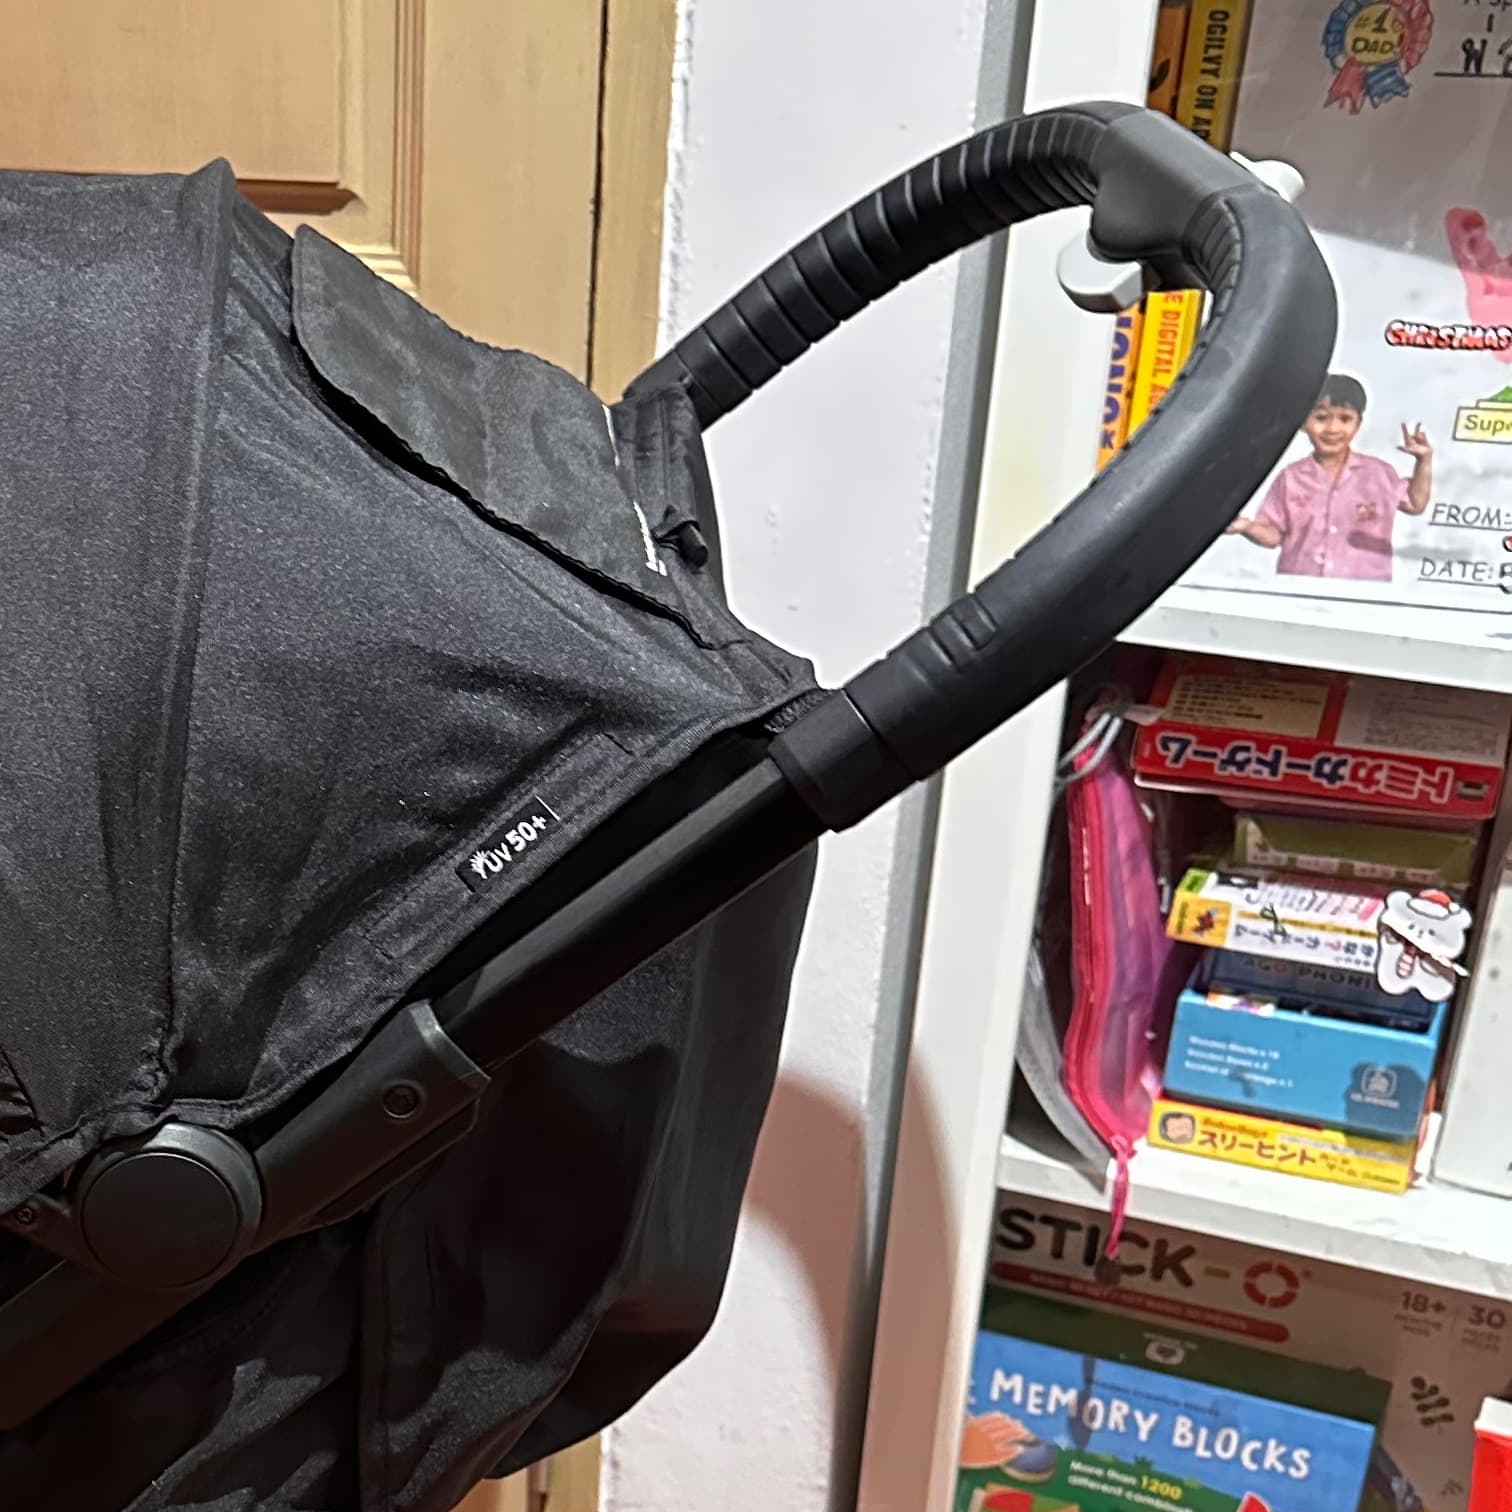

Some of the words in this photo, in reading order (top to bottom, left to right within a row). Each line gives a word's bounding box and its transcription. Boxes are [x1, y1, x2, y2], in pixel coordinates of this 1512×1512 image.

[1199, 9, 1230, 80] OGILVY
[1194, 85, 1218, 111] ON
[1152, 310, 1181, 378] DIGITAL
[486, 842, 512, 873] UV
[505, 815, 547, 852] 50+
[1468, 1305, 1506, 1330] 30
[990, 1368, 1159, 1442] MEMORY
[1172, 1416, 1312, 1480] BLOCKS
[1140, 1475, 1183, 1501] 1200
